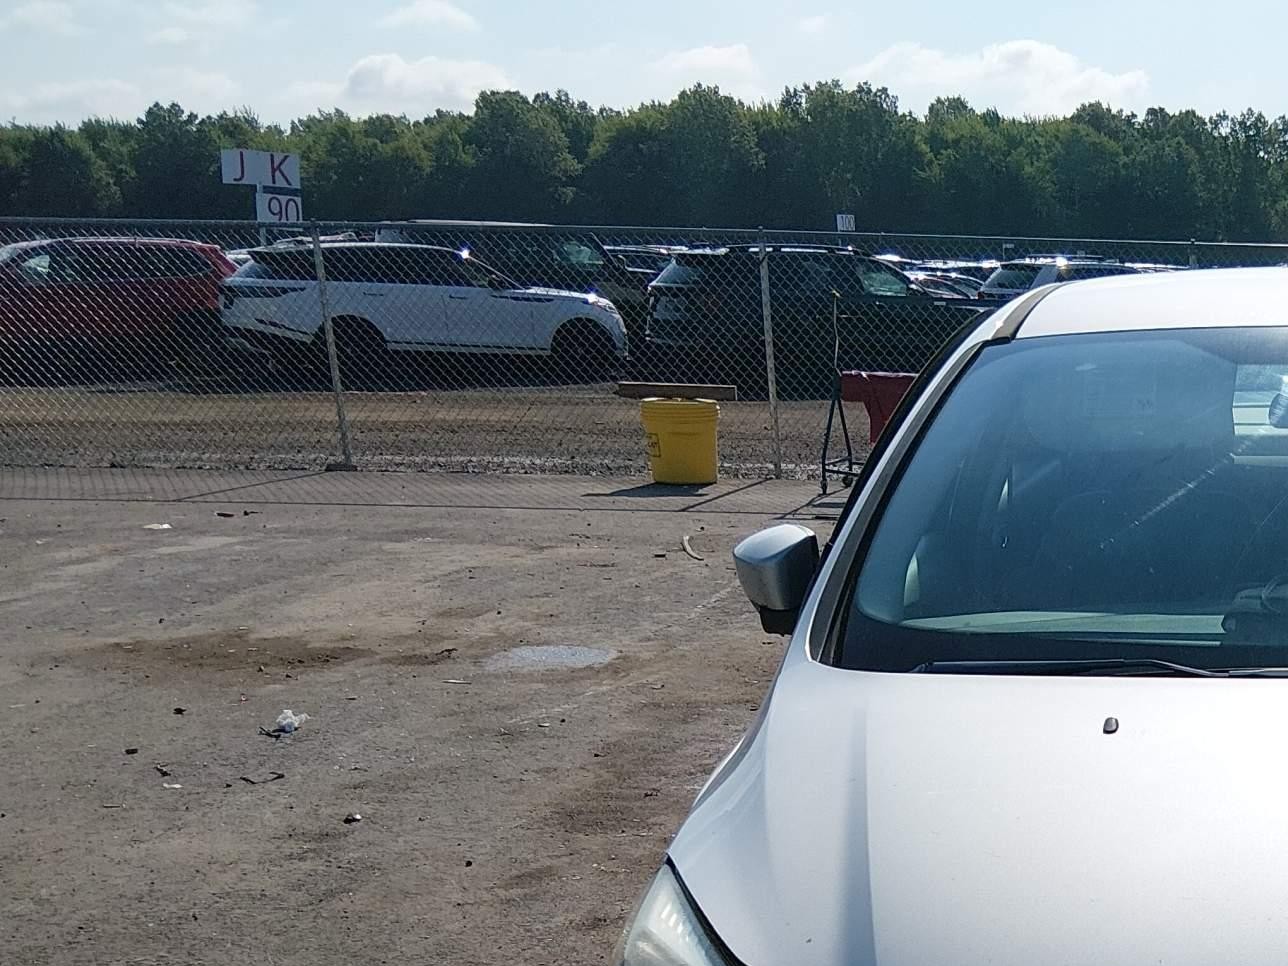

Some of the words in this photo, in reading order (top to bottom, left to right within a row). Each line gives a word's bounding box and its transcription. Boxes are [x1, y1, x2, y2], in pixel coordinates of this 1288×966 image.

[233, 150, 245, 182] J
[269, 153, 293, 186] K
[267, 196, 301, 221] 90
